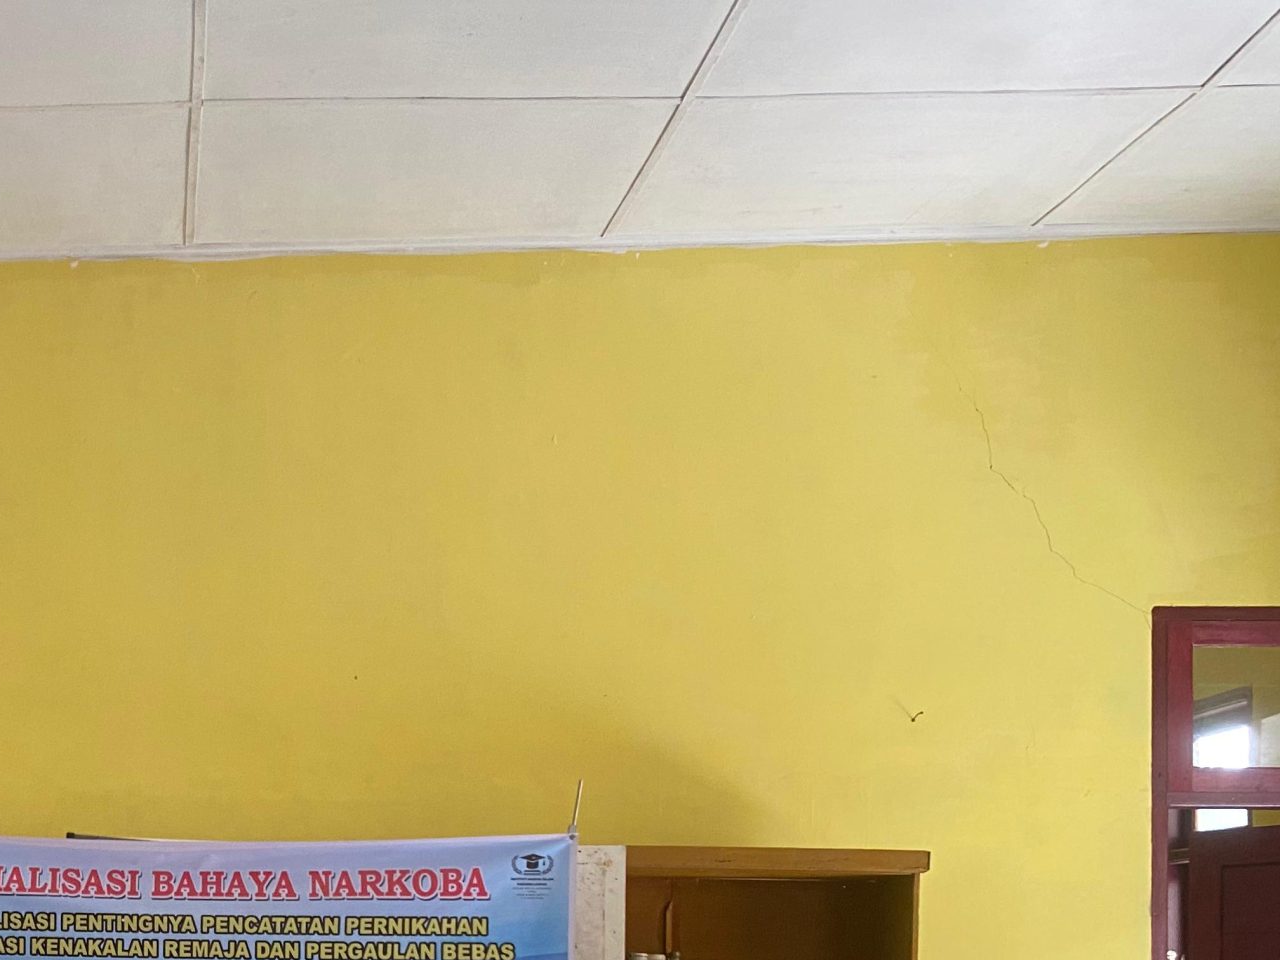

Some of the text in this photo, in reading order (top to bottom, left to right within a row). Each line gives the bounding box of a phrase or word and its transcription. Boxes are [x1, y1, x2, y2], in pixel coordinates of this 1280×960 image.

[151, 869, 299, 899] BAHAYA
[308, 866, 491, 899] NARKOBA
[61, 913, 196, 933] PENTINGNYA
[201, 915, 339, 935] PENCATATAN
[345, 916, 489, 936] PERNIKAHAN
[30, 937, 159, 958] KENAKALAN
[163, 939, 251, 960] REMAJA
[255, 940, 300, 960] DAN
